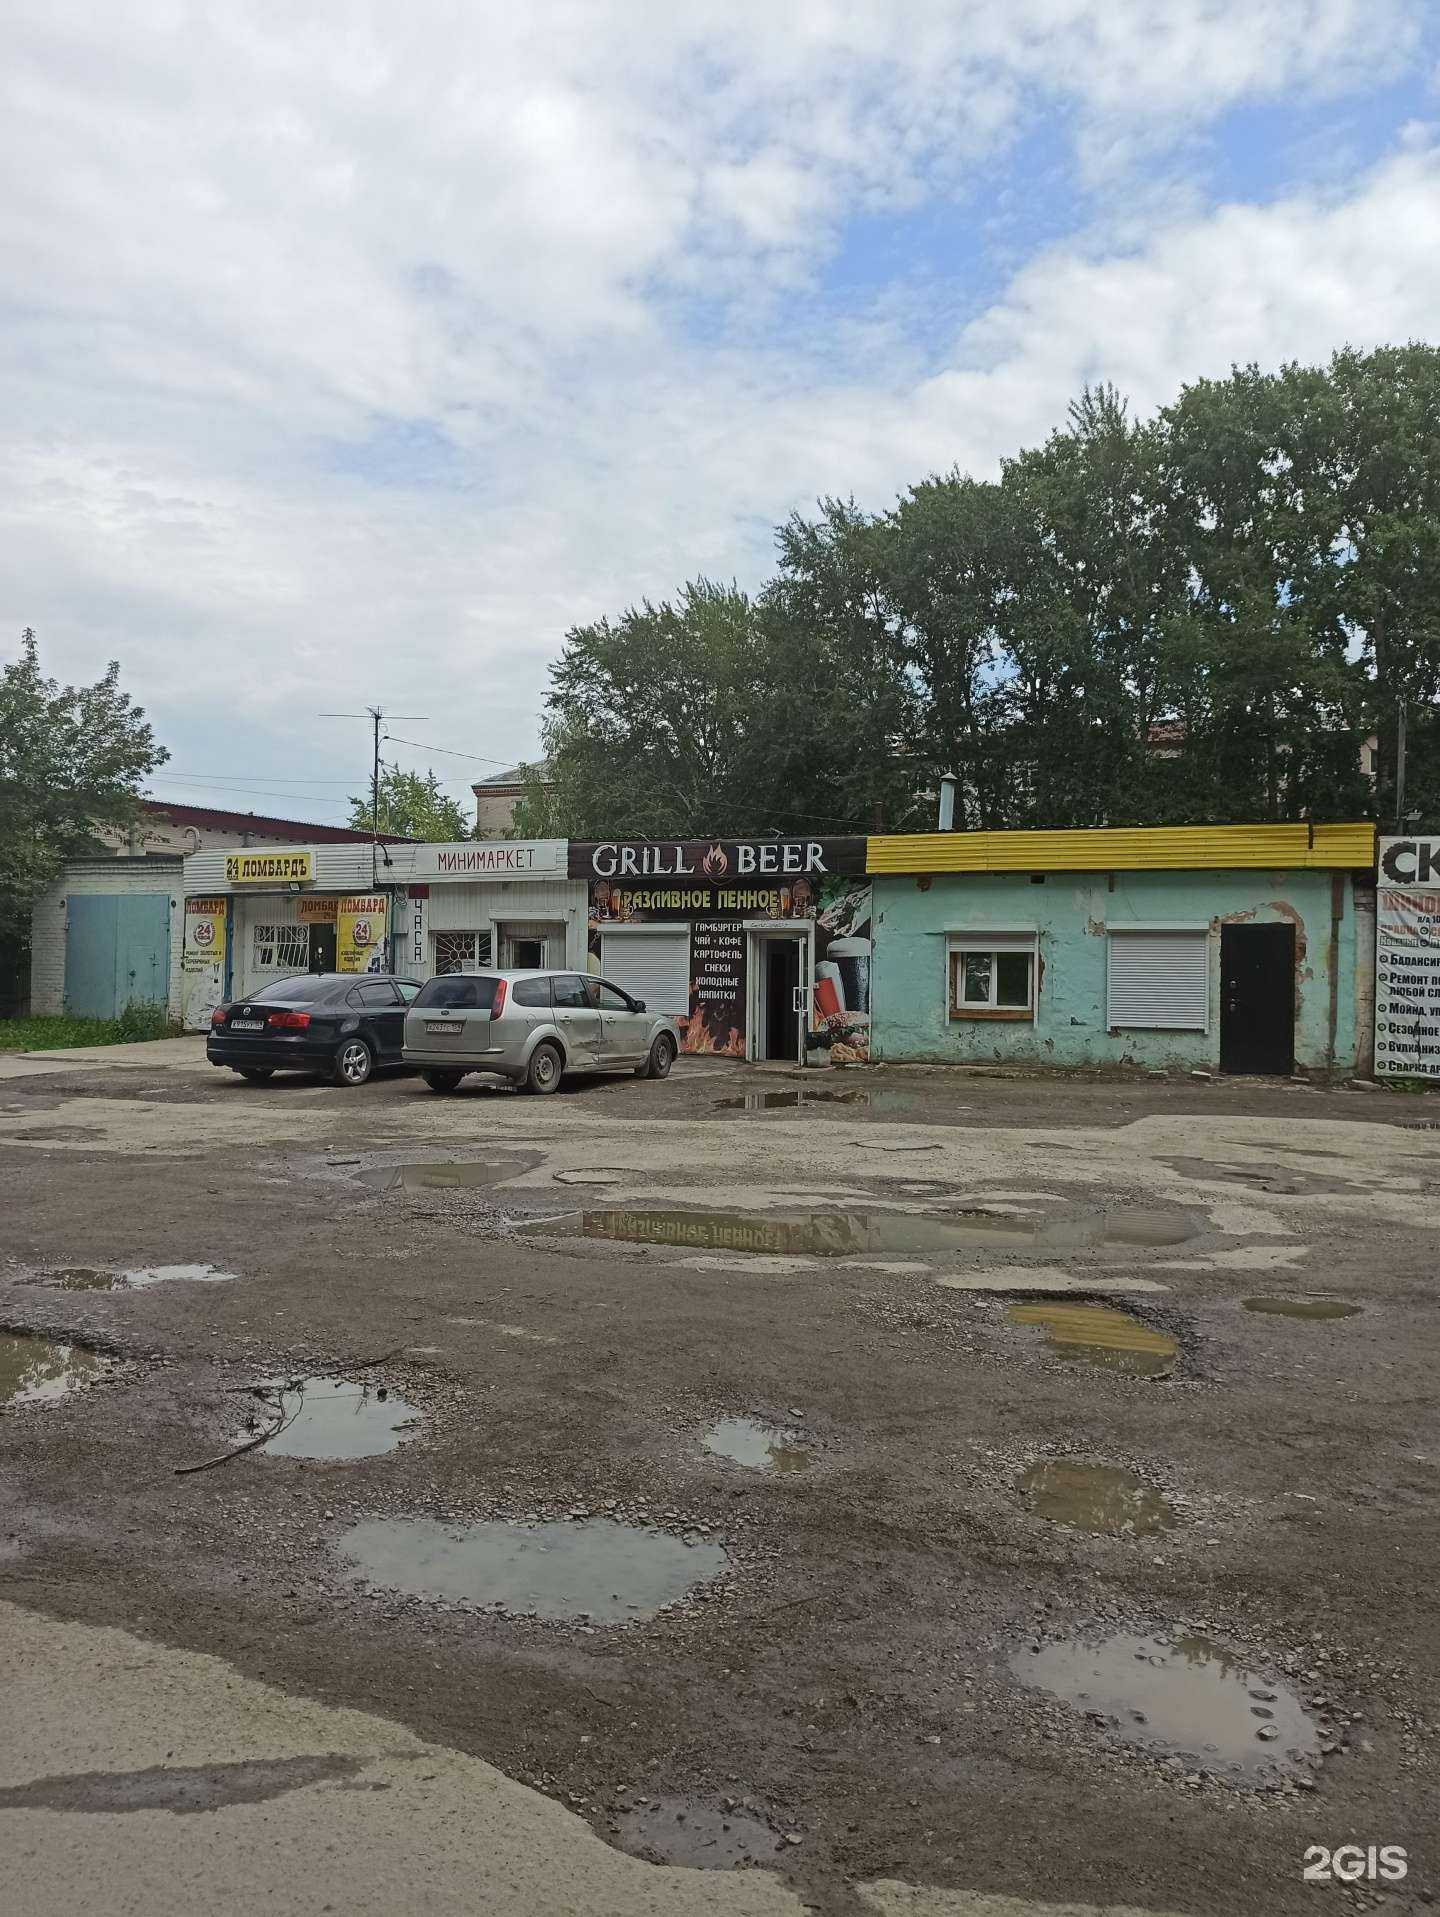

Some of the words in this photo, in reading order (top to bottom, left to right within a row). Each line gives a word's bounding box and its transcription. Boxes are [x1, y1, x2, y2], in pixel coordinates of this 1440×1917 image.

[438, 849, 536, 871] МИНИМАРКЕТ
[736, 841, 829, 873] BEER
[242, 858, 307, 878] ЛОМБАРДЪ
[622, 889, 711, 909] РАЗЛИВНОЕ
[718, 889, 779, 909] ПЕННОЕ
[186, 899, 225, 915] ЛОМБАРД
[341, 898, 385, 914] ЛОМБАРД
[198, 924, 211, 935] 24
[356, 924, 368, 935] 24
[695, 922, 742, 932] ГАМБУРГЕР
[694, 935, 711, 946] ЧАЙ
[719, 936, 742, 946] КОФЕ
[694, 949, 742, 959] КАРТОФЕЛЬ
[704, 963, 731, 973] СНЕКИ
[695, 976, 739, 987] ХОЛОДНЫЕ
[1390, 972, 1428, 985] РЕМОНТ
[698, 990, 736, 1000] НАПИТКИ
[1390, 986, 1425, 998] ЛЮБОЙ
[1388, 1060, 1427, 1074] СВАРКА
